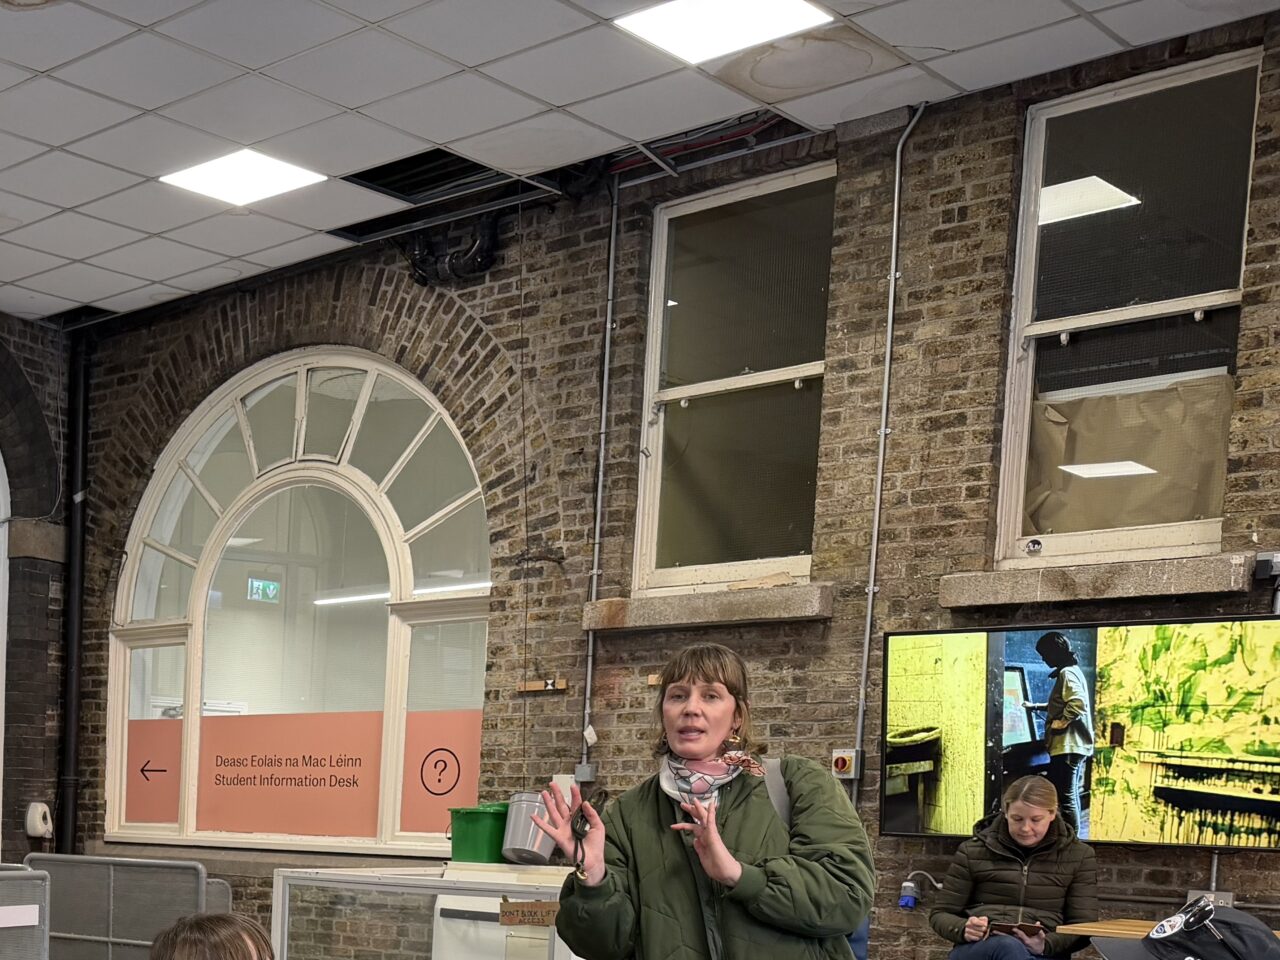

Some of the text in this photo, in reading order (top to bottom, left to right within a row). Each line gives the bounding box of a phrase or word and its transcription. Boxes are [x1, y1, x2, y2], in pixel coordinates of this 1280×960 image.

[215, 754, 362, 768] Deasc Eolais na Mac Léinn
[214, 773, 359, 788] Student Information Desk
